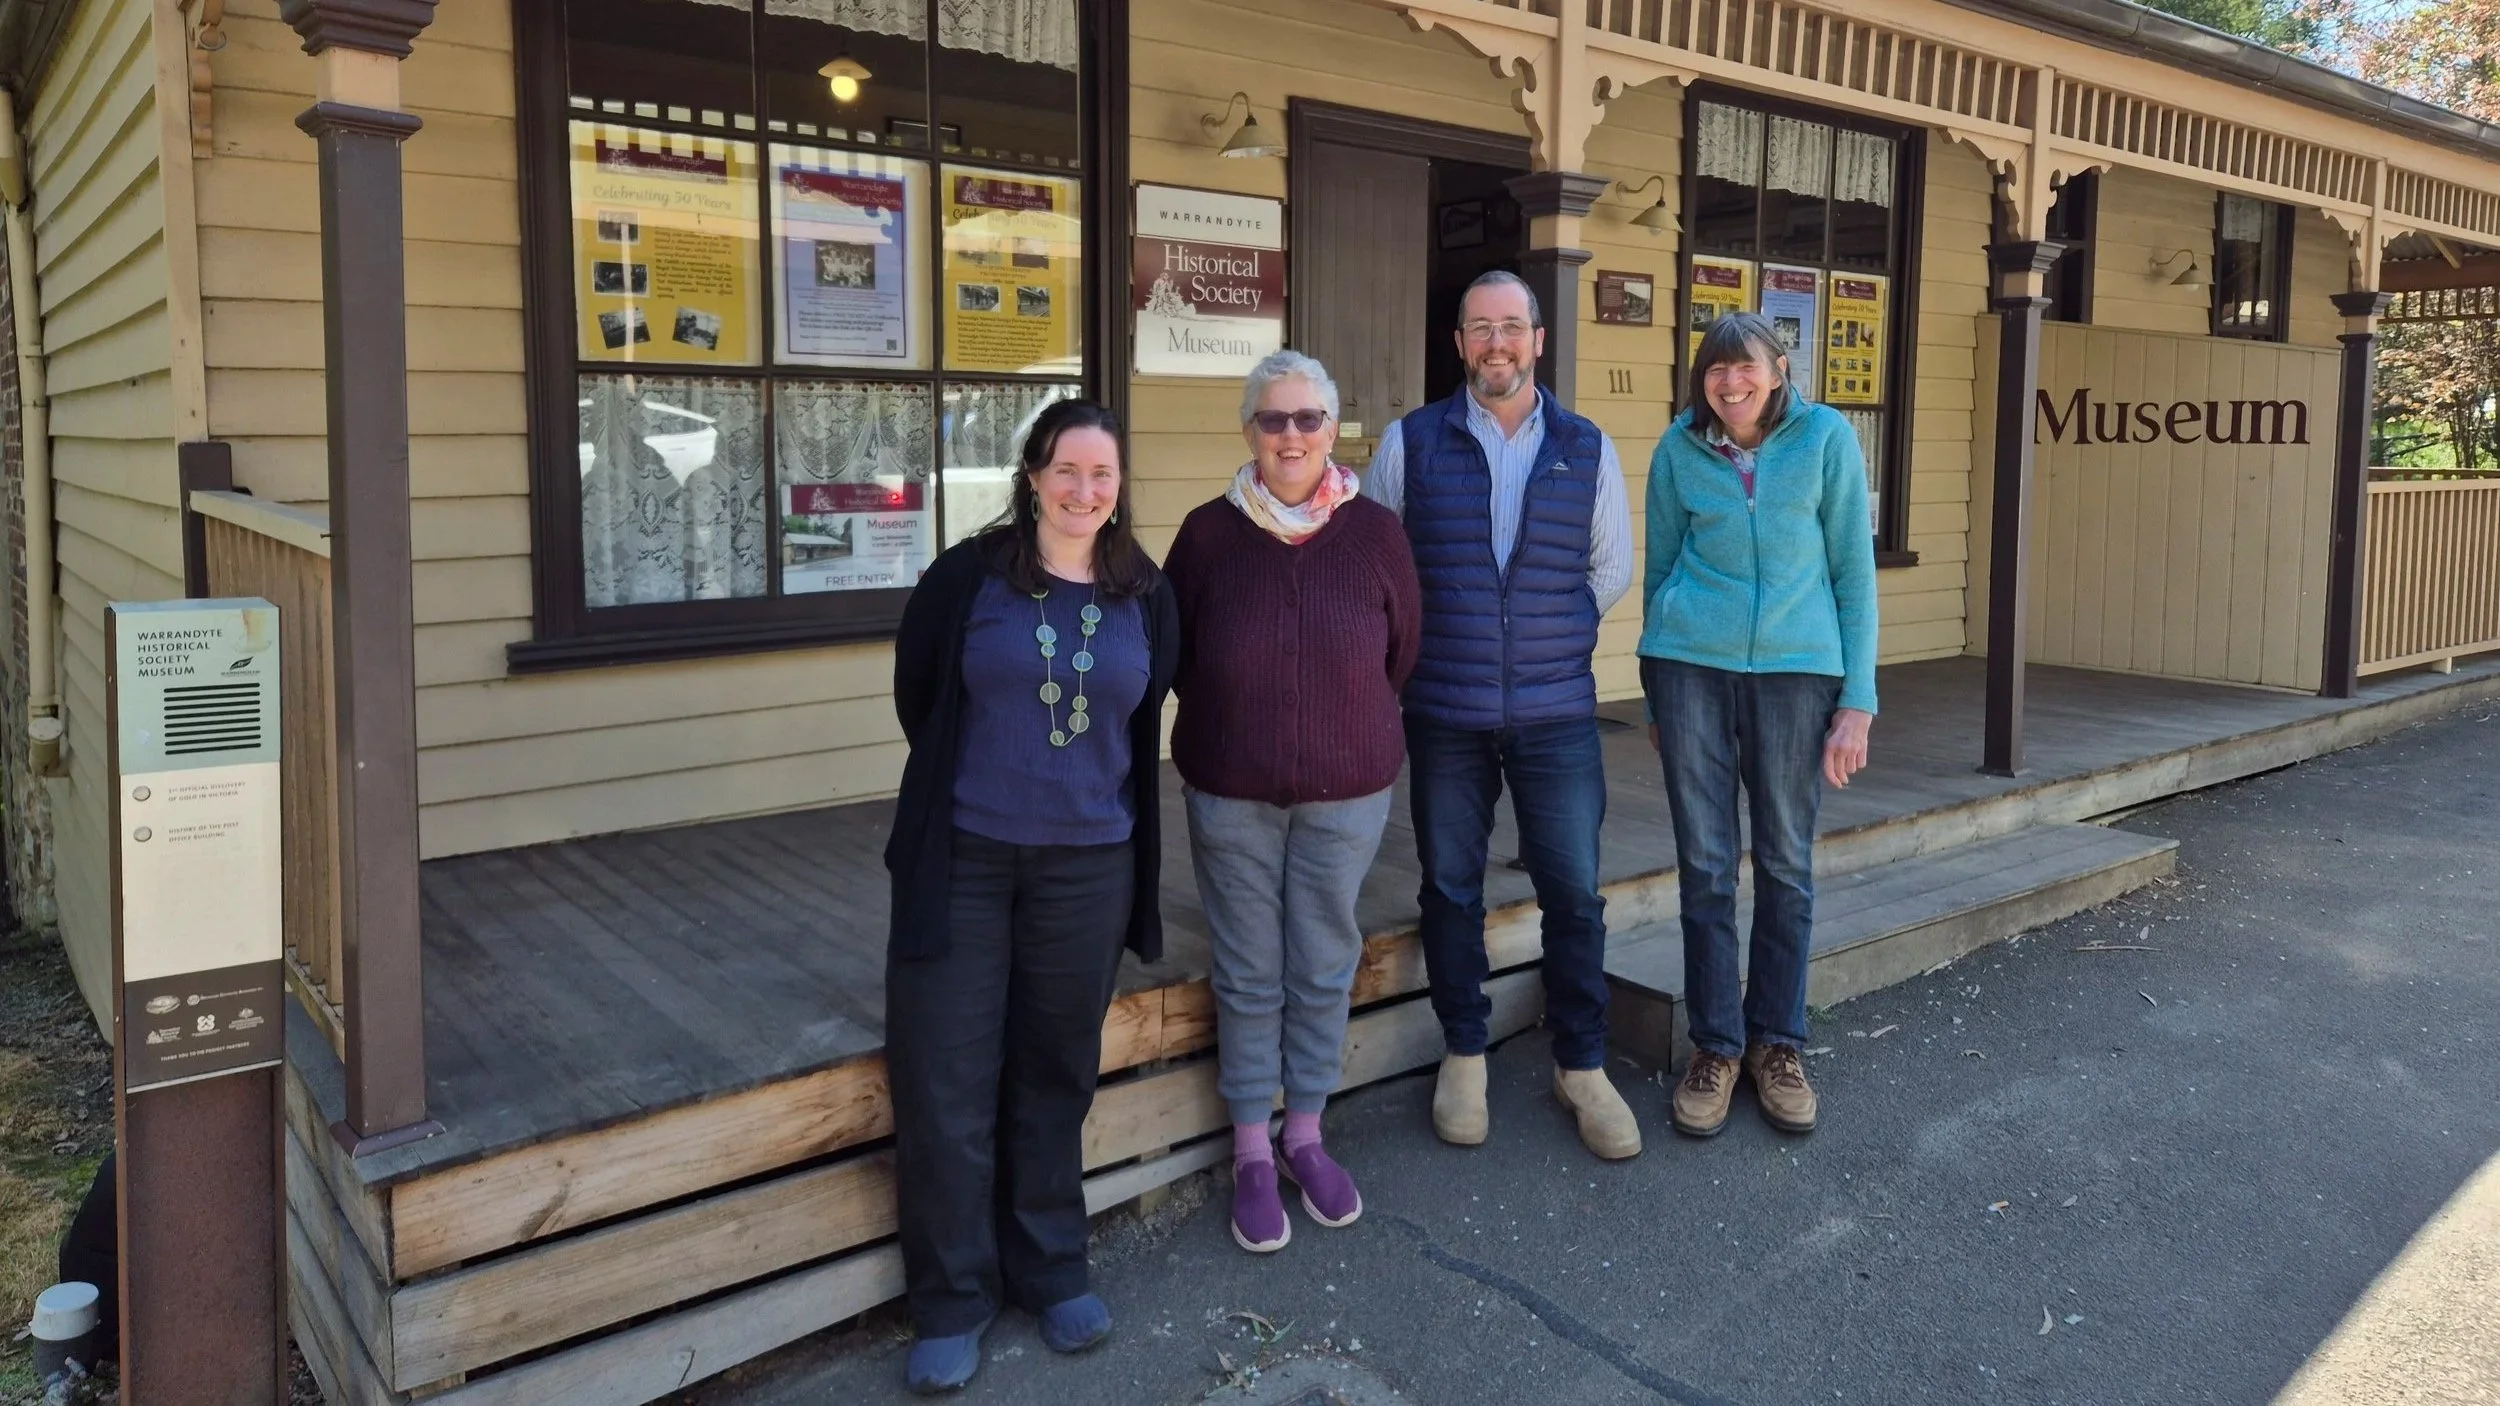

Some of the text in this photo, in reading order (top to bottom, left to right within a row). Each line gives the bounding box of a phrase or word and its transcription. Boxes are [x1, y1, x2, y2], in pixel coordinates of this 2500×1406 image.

[593, 184, 732, 210] Celebrating 50 Years
[1160, 211, 1262, 229] WARRANDYTE
[1164, 244, 1260, 278] Historical
[1191, 275, 1262, 312] Society
[1168, 327, 1252, 356] Museum
[1608, 368, 1633, 394] 111
[2034, 388, 2310, 445] Museum
[867, 519, 917, 530] Museum
[825, 572, 895, 587] FREE ENTRY
[137, 628, 223, 641] WARRANDYTE
[137, 642, 211, 653] HISTORICAL
[138, 654, 190, 666] SOCIETY
[138, 666, 195, 677] MUSEUM
